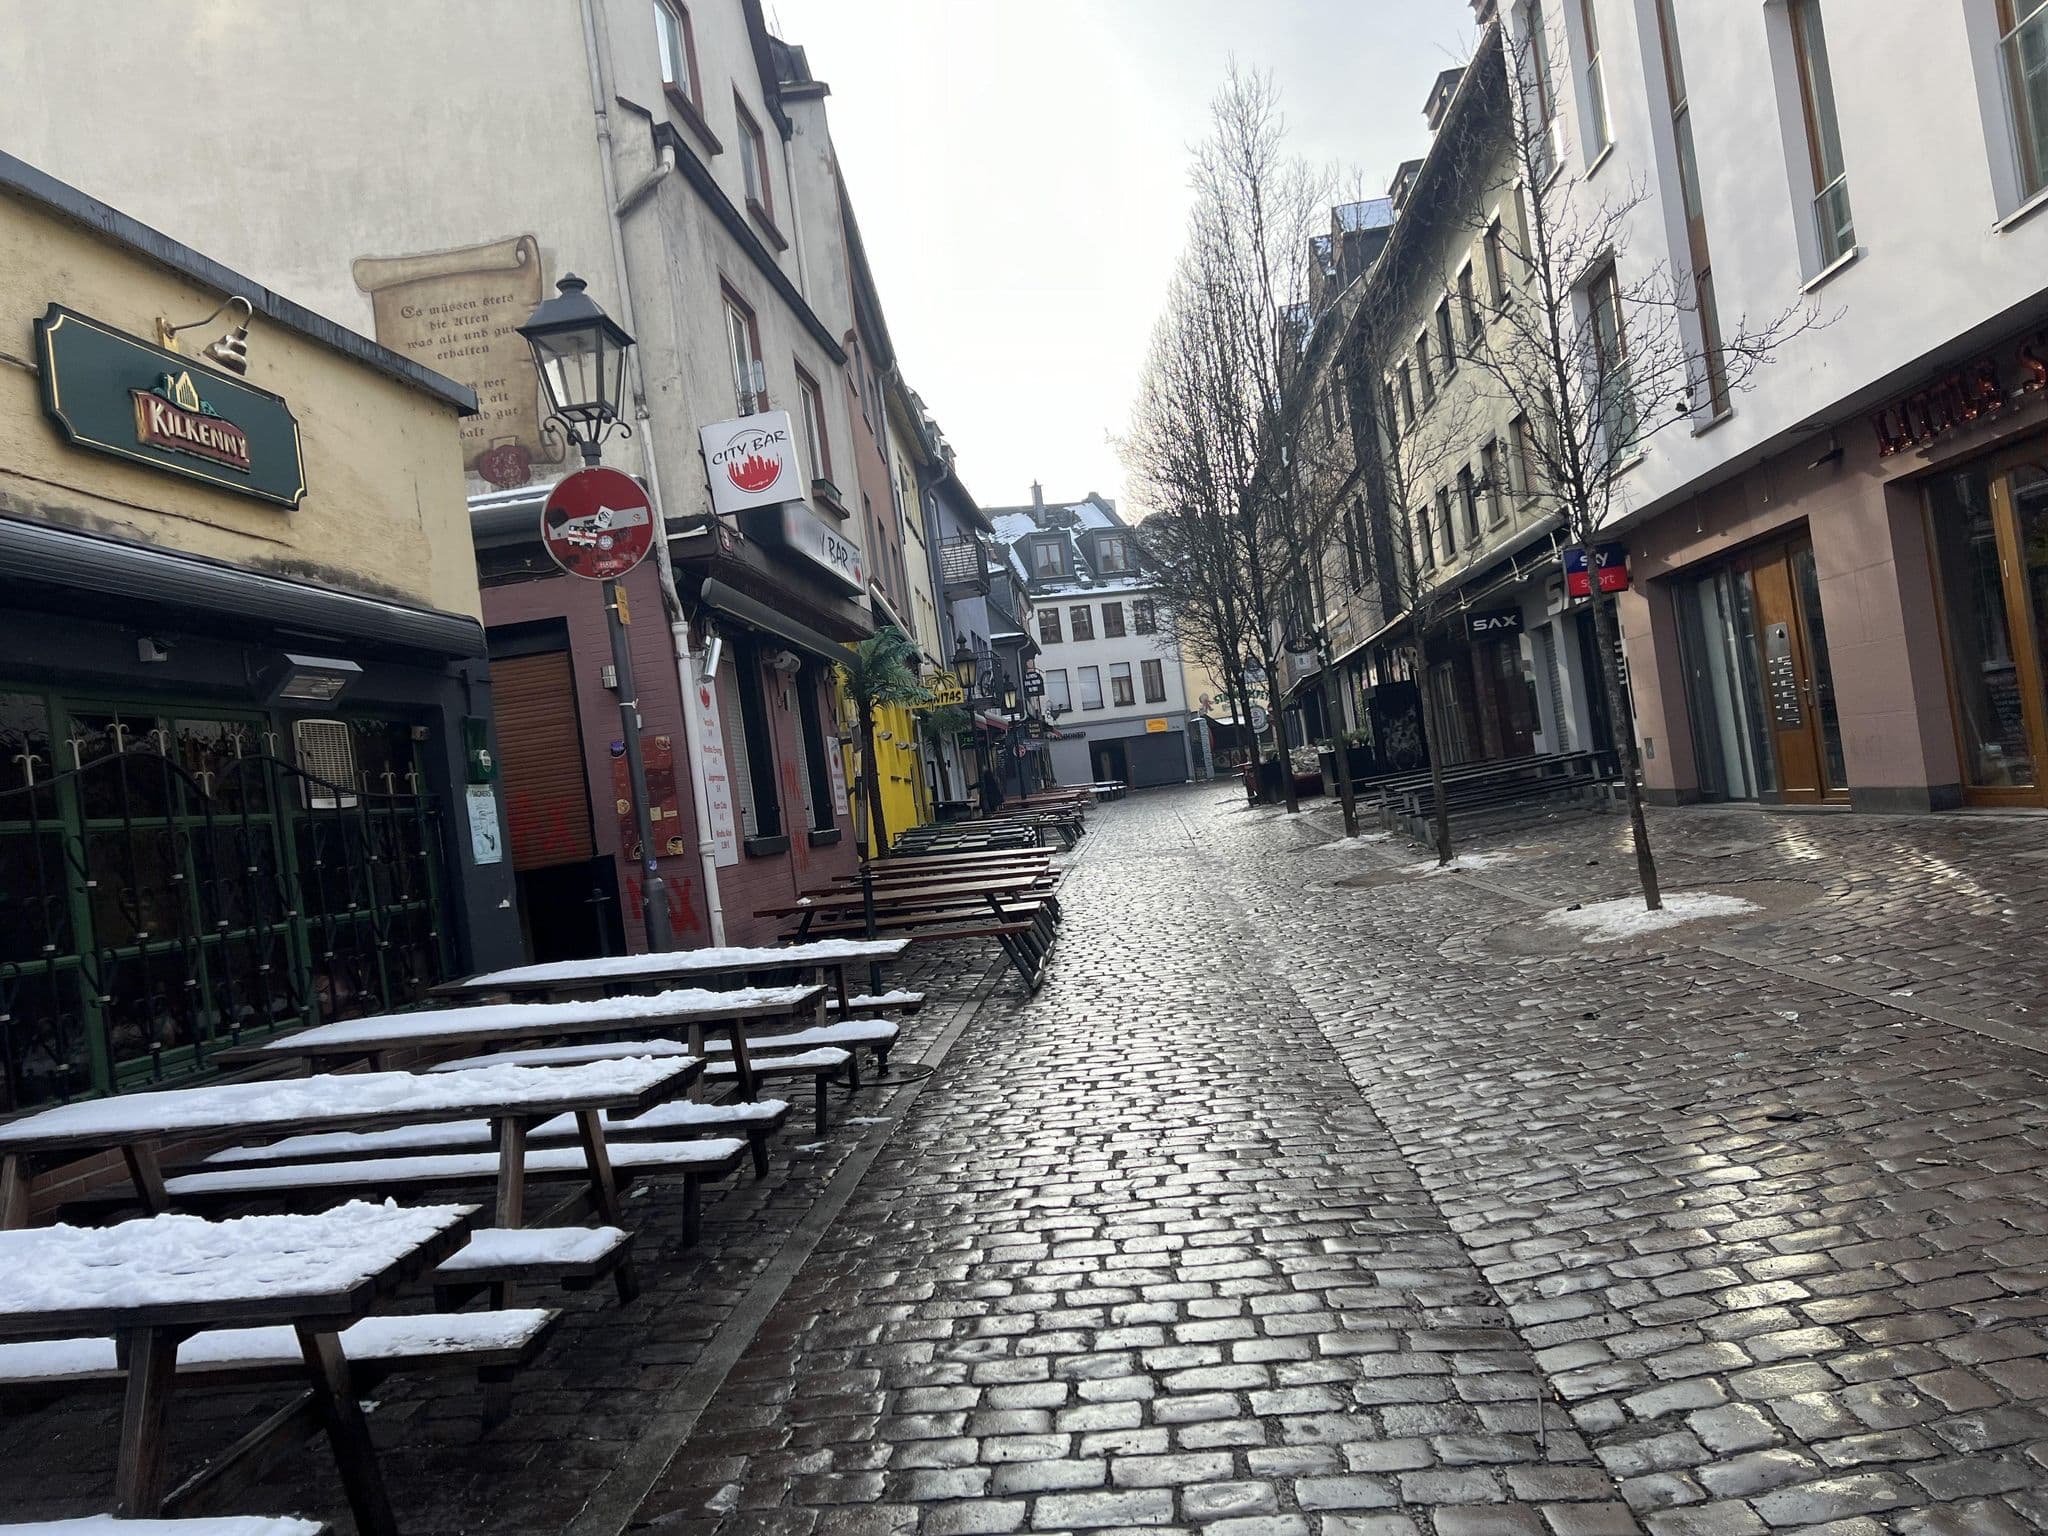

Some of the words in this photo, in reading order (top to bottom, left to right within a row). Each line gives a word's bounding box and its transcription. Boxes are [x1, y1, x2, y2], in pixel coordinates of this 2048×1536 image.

[429, 301, 477, 315] müssen
[430, 319, 447, 331] die
[455, 315, 488, 326] Alten
[406, 338, 433, 348] was
[439, 334, 457, 344] alt
[464, 329, 488, 340] und
[437, 346, 490, 360] erhalten
[484, 377, 506, 390] wer
[148, 398, 248, 459] KILKENNY
[712, 442, 747, 466] CITY
[752, 429, 788, 452] BAR
[828, 535, 850, 572] BAR
[1472, 614, 1518, 631] SAX
